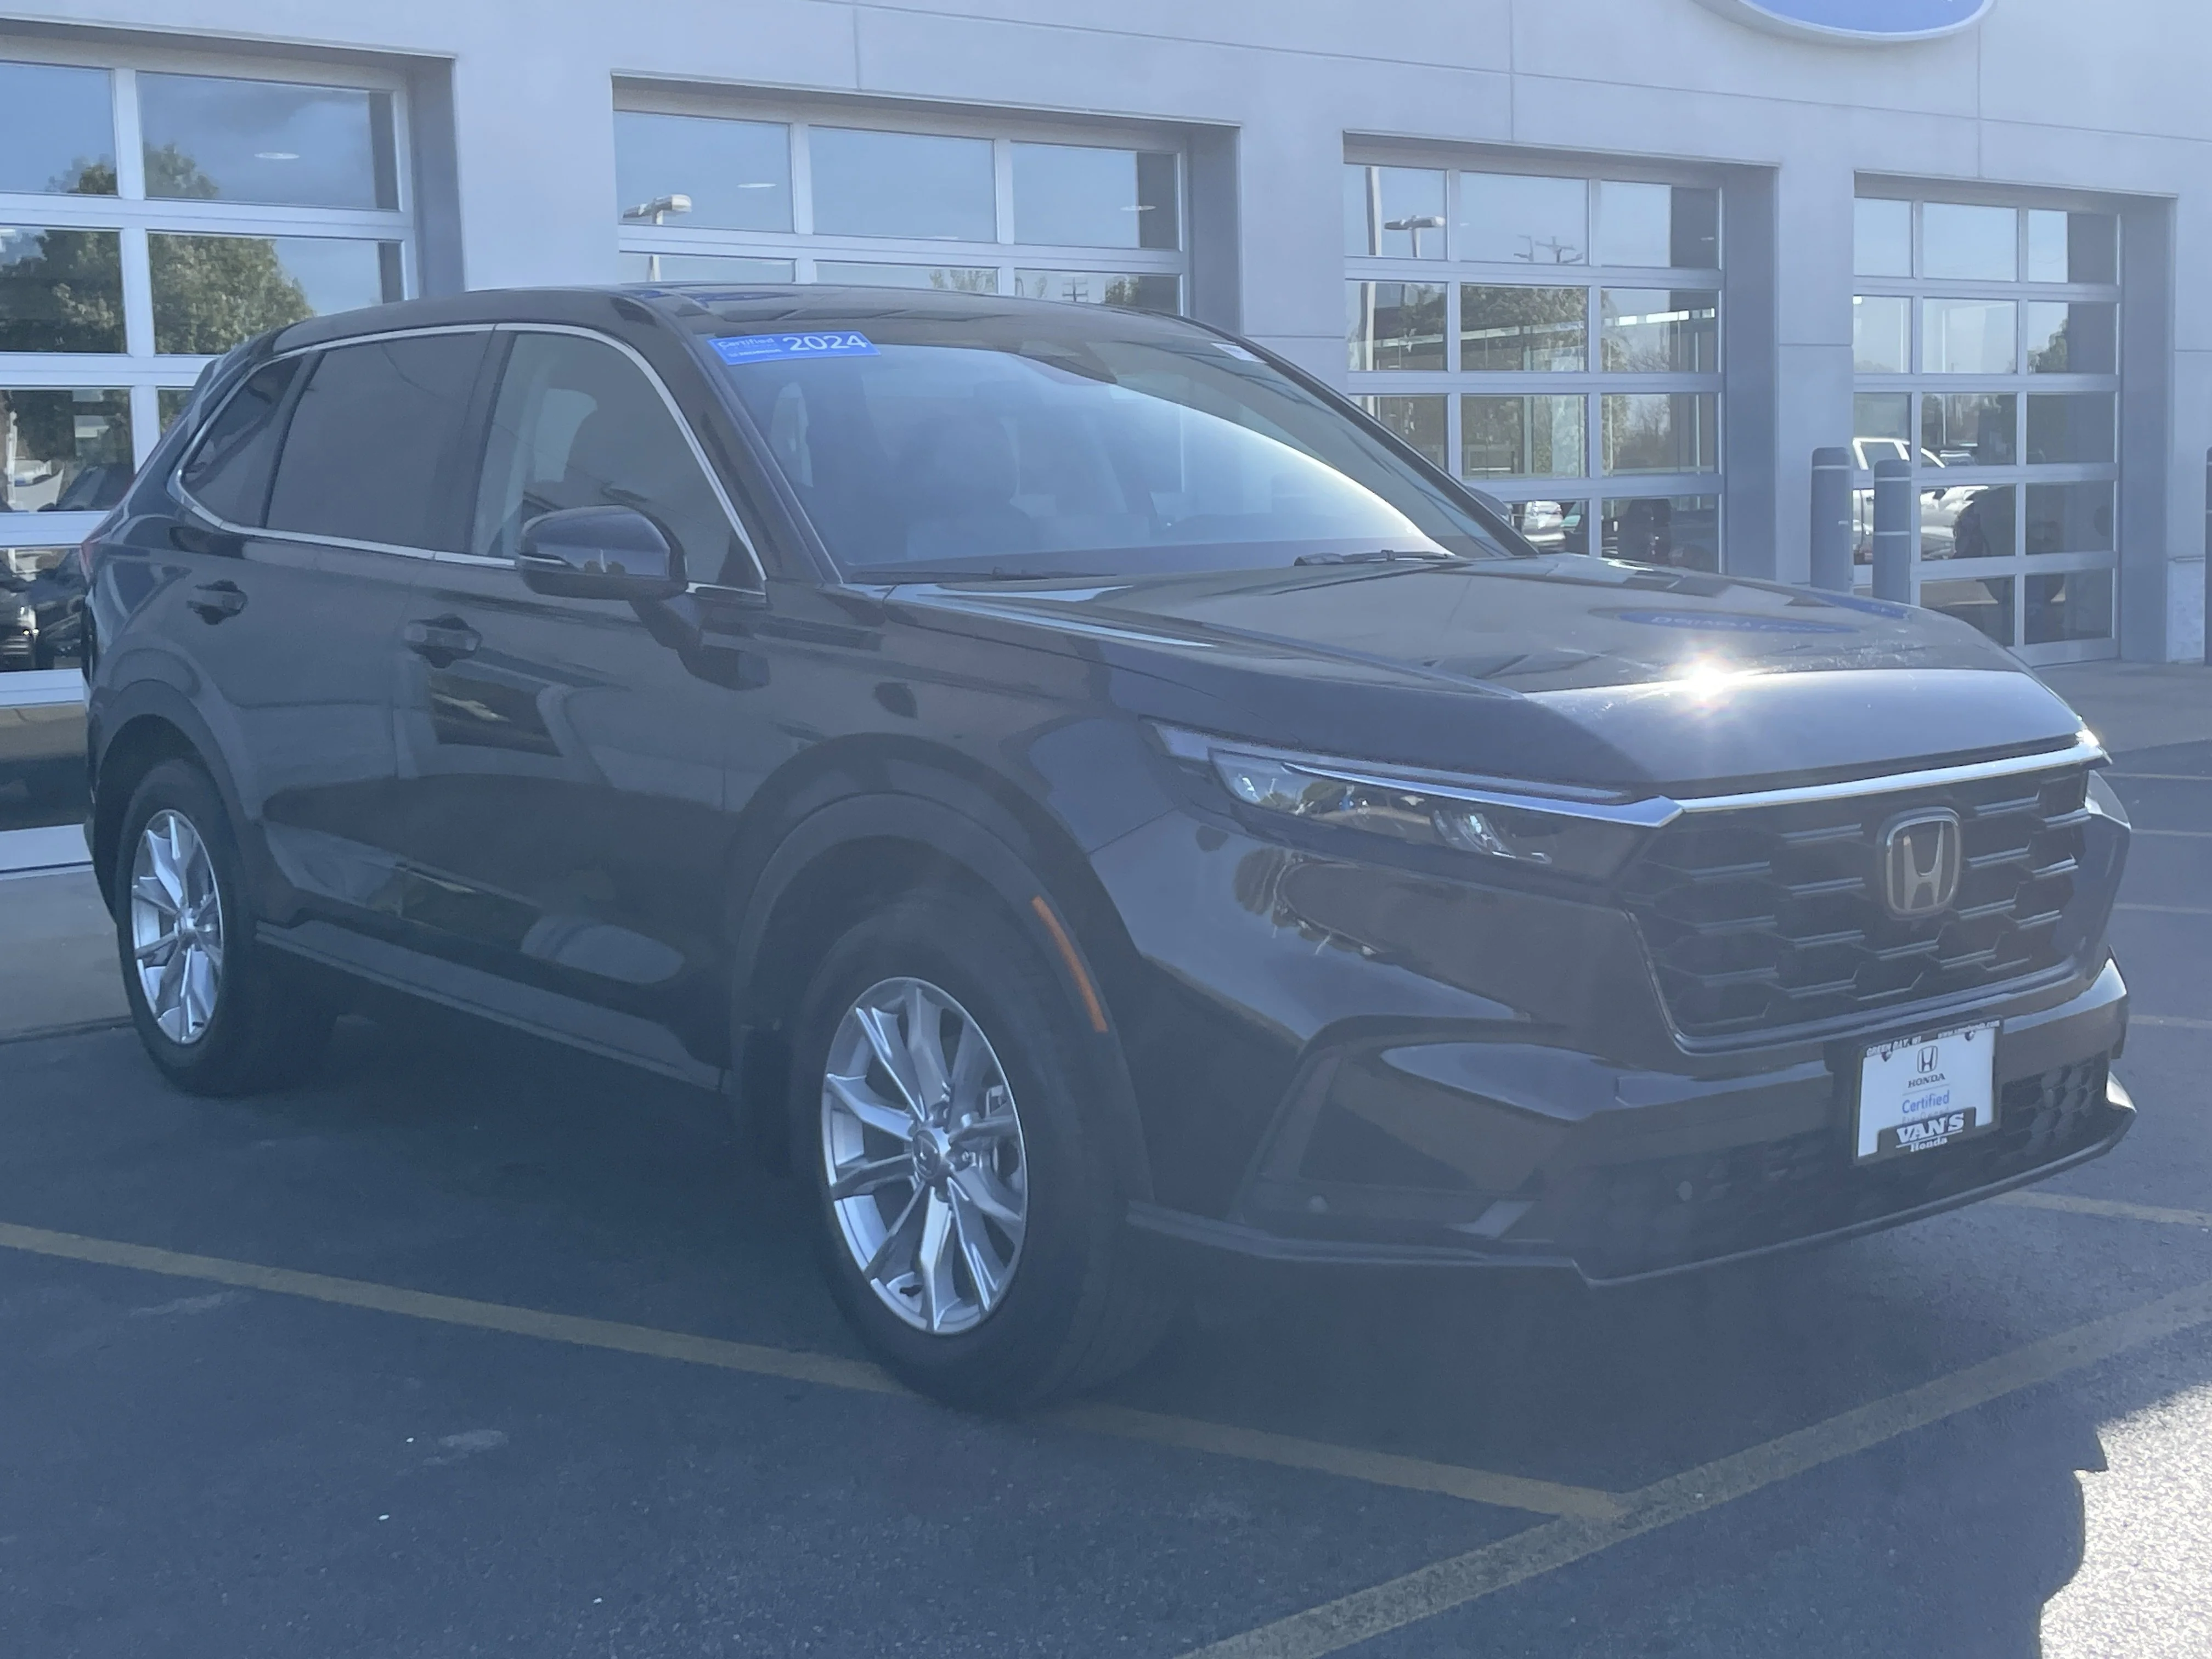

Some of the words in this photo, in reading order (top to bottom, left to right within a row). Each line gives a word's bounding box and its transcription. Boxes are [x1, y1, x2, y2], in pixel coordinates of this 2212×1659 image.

[782, 335, 868, 351] 2024
[1908, 1073, 1946, 1088] HONDA
[1902, 1090, 1950, 1113] Certified
[1910, 1137, 1948, 1152] Honda
